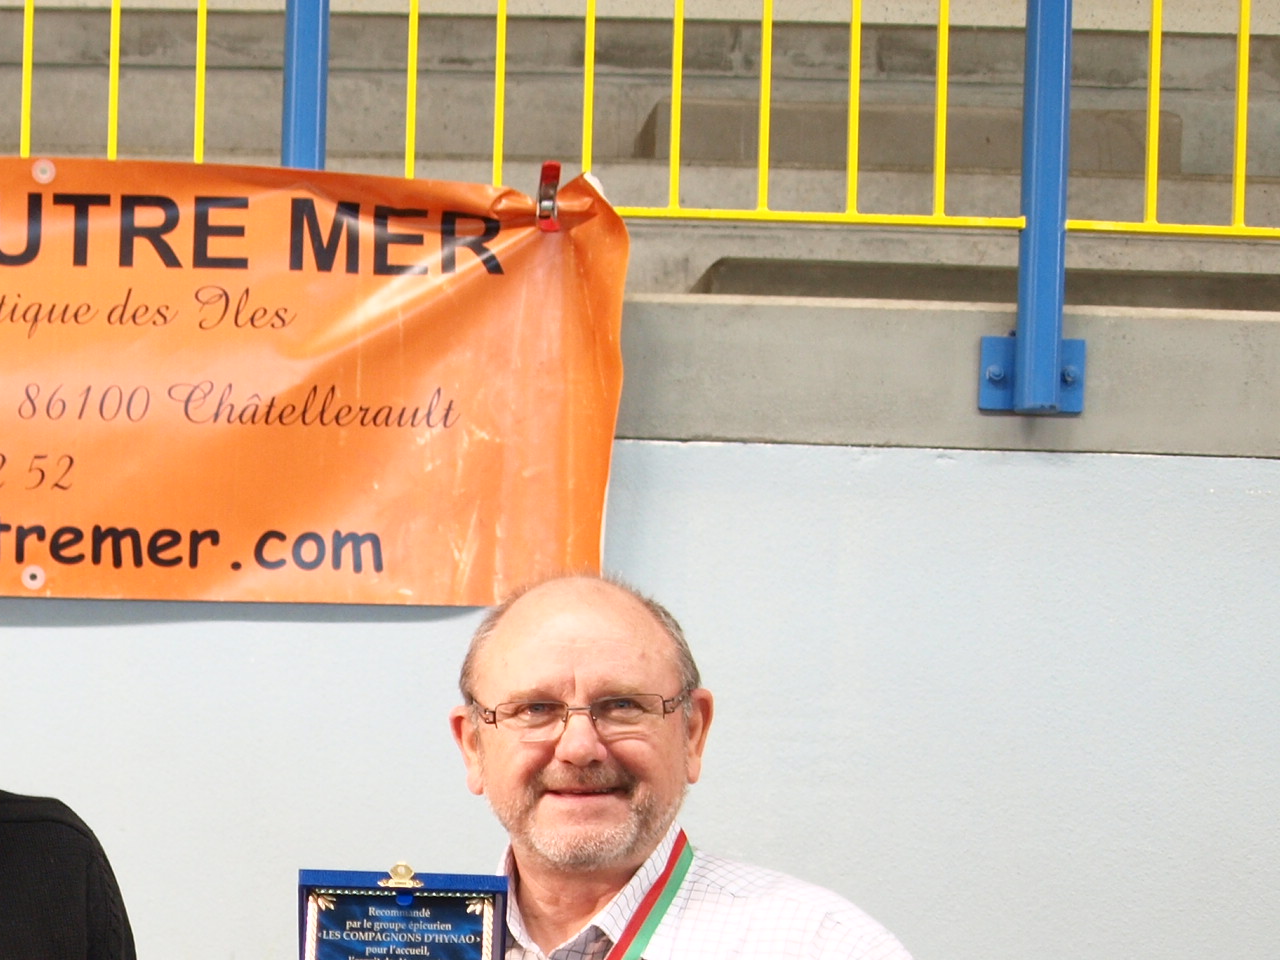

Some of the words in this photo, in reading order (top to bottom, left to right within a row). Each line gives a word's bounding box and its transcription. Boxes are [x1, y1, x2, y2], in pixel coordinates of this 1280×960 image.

[288, 197, 506, 277] MER
[98, 283, 175, 327] des
[17, 382, 151, 423] 86100
[167, 380, 460, 429] Châtellerault
[24, 454, 76, 491] 52
[368, 906, 431, 918] Recommandé
[343, 931, 422, 942] COMPAGNONS
[345, 920, 361, 932] par
[363, 919, 372, 930] le
[373, 921, 407, 932] groupe
[408, 921, 452, 932] épicurien
[365, 946, 387, 956] pour
[389, 945, 430, 957] l'accueil,
